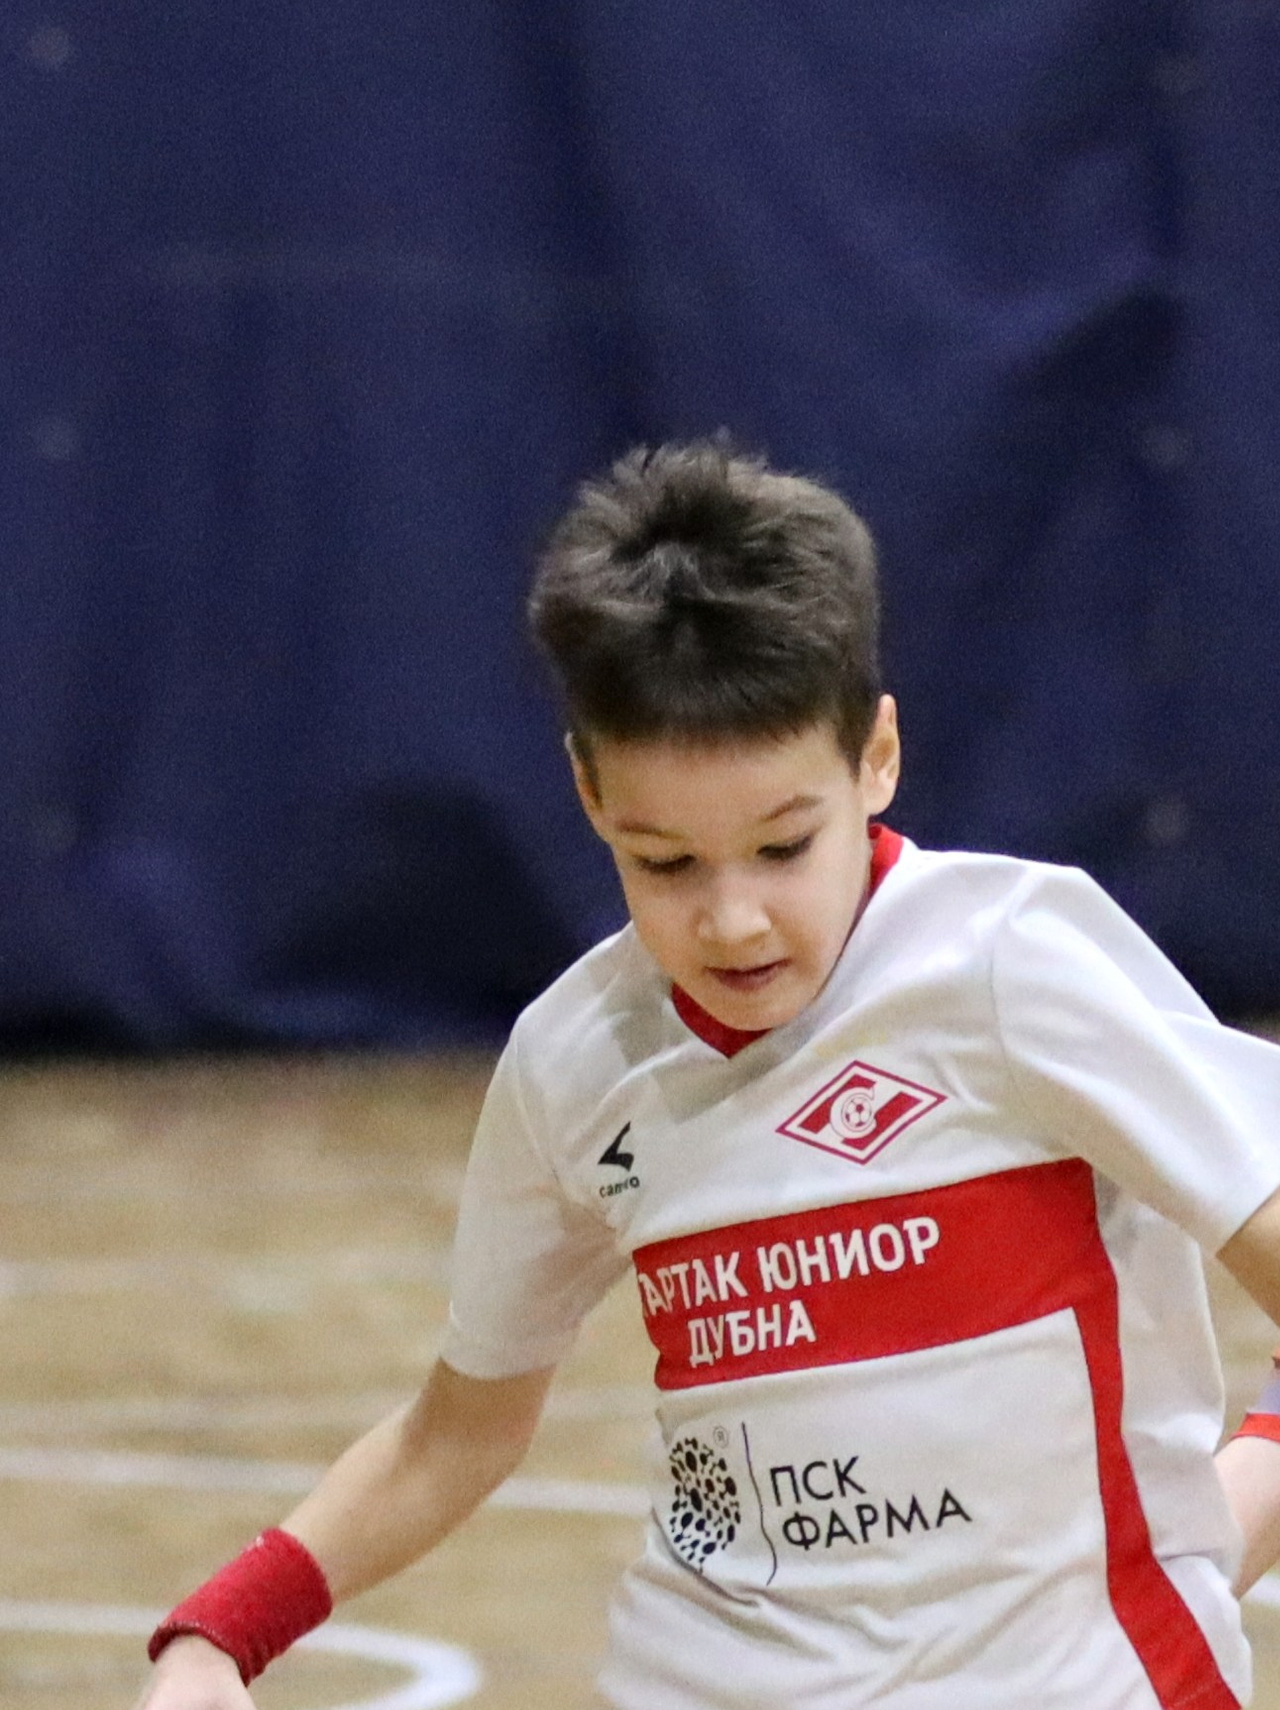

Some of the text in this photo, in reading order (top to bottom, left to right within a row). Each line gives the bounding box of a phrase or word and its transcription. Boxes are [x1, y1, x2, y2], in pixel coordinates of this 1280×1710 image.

[638, 1216, 940, 1317] АРТАК ЮНИОР
[687, 1299, 817, 1368] ДУБНА
[769, 1455, 867, 1507] ПСК
[782, 1487, 973, 1551] ФАРМА
